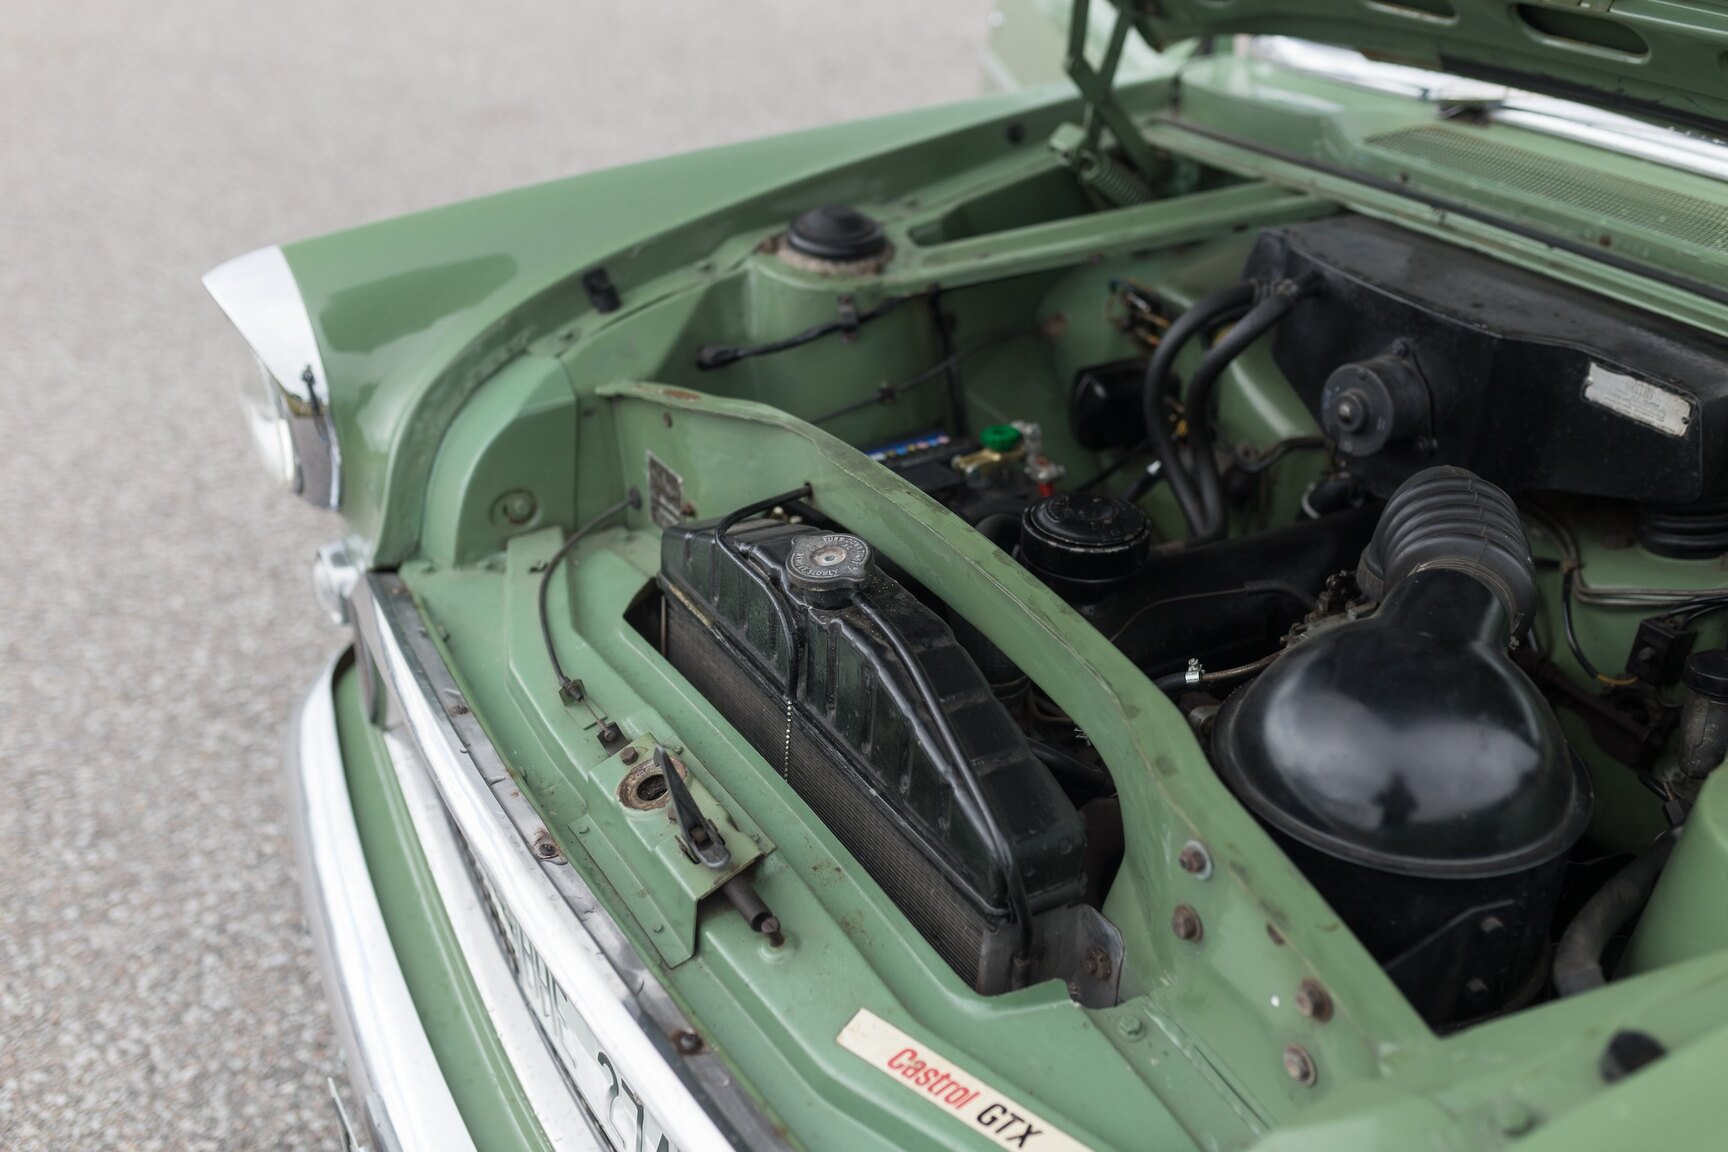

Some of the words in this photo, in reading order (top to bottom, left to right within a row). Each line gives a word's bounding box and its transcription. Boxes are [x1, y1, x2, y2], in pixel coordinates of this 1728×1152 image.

[806, 568, 839, 576] SLOWLY
[886, 1047, 981, 1110] Castrol
[976, 1103, 1044, 1149] GTX
